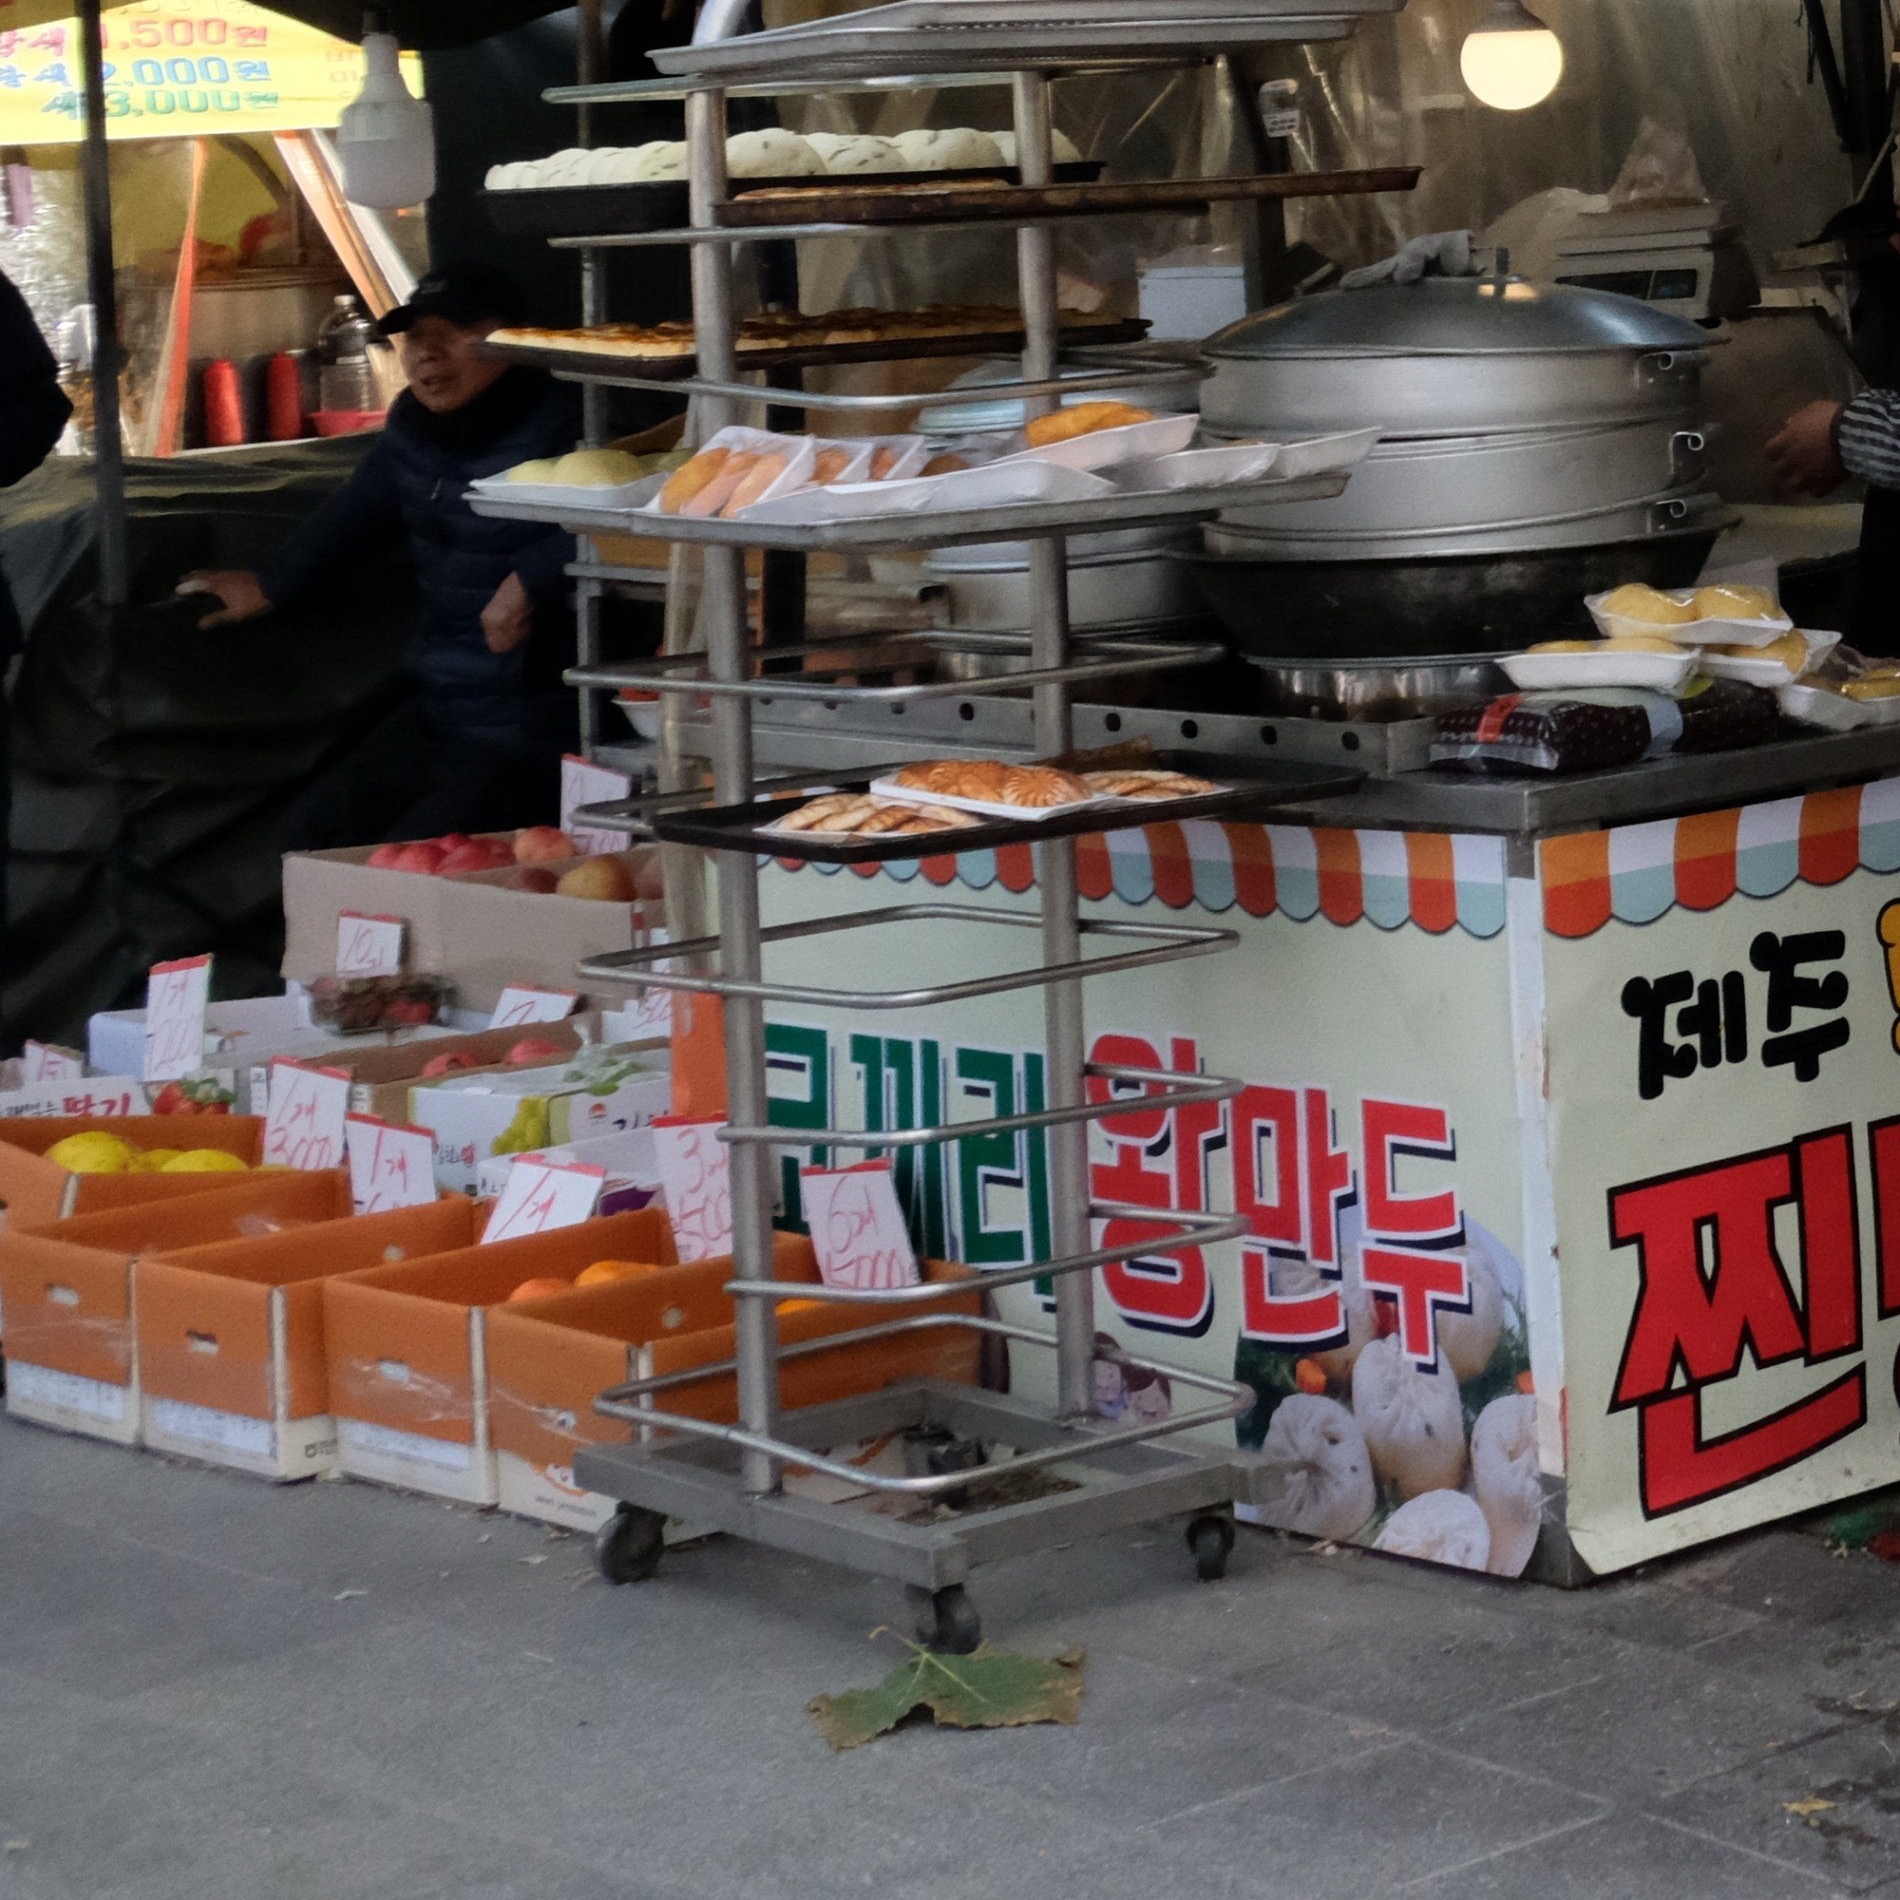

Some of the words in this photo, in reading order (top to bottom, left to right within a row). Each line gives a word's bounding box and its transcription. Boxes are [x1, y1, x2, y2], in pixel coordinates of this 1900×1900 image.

[1620, 930, 1851, 1100] 제주
[763, 1022, 1056, 1313] 코끼리
[1086, 1032, 1476, 1376] 왕만두
